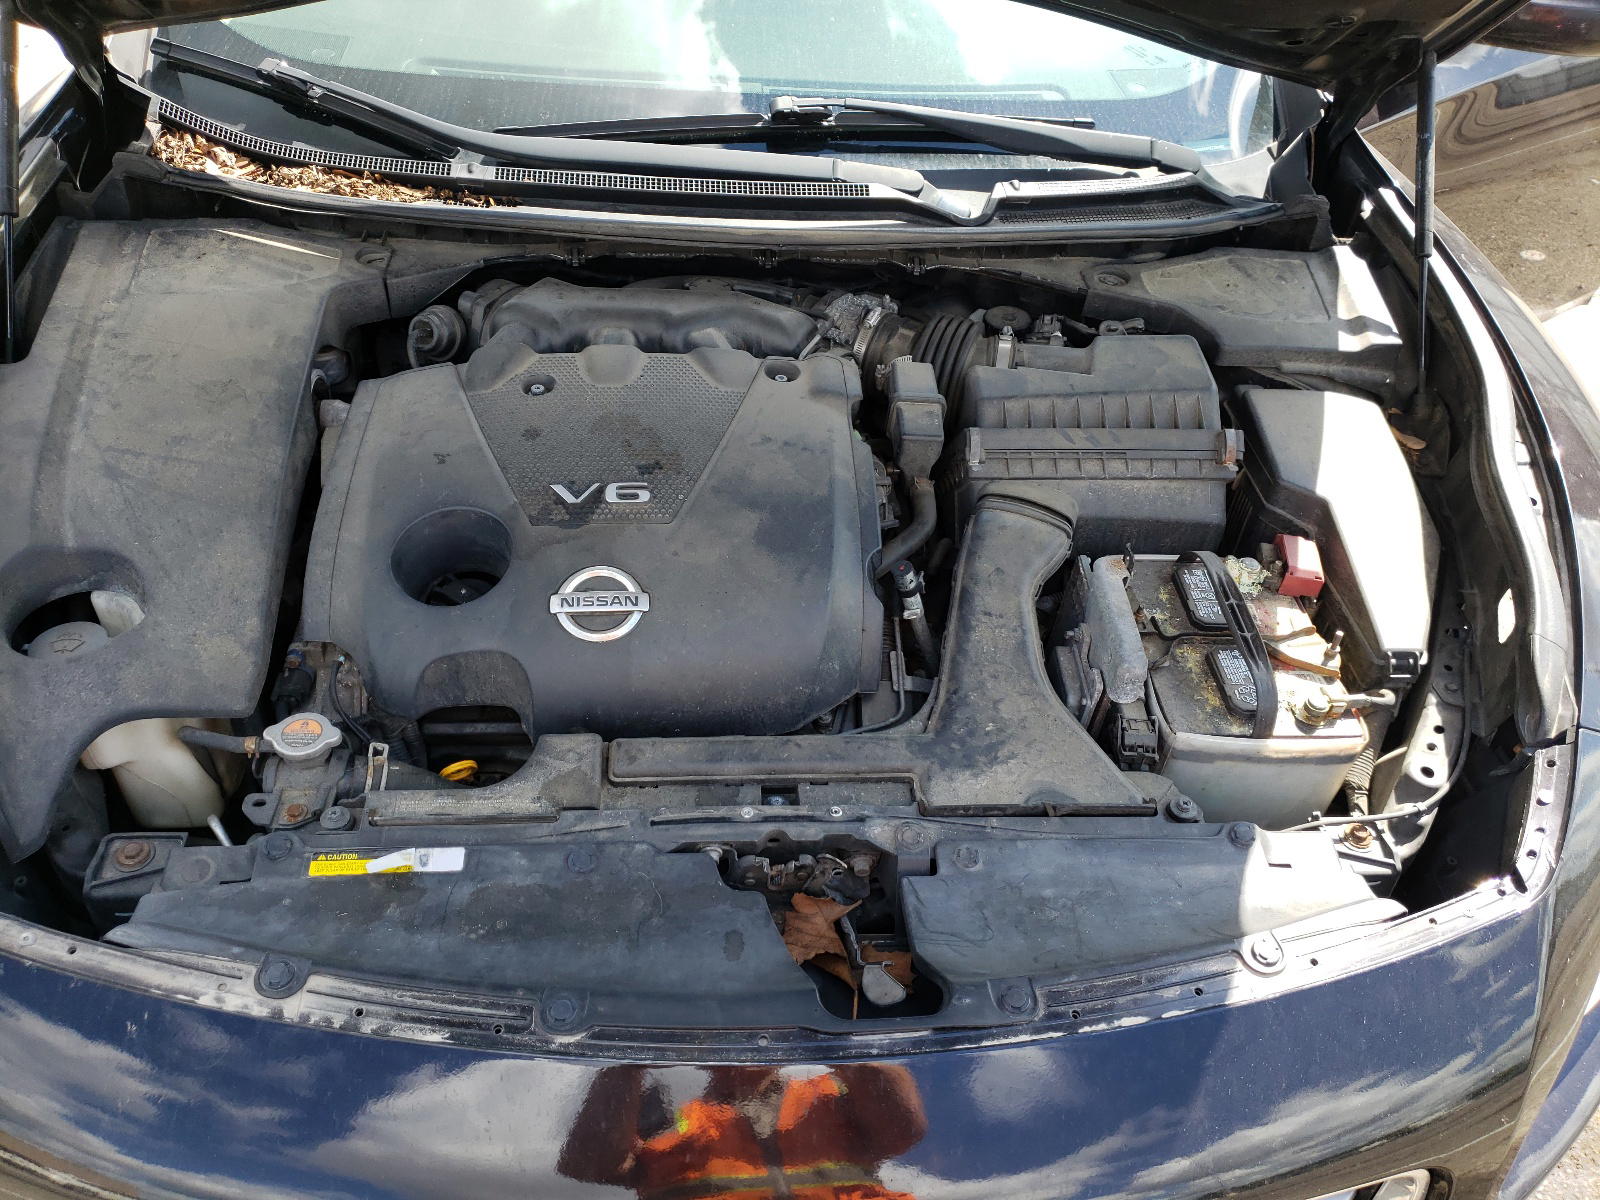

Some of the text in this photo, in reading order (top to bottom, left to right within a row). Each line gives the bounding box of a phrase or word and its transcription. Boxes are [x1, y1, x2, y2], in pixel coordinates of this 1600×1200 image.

[550, 482, 650, 504] V6
[560, 595, 639, 608] NISSAN
[327, 853, 358, 861] CAUTION
